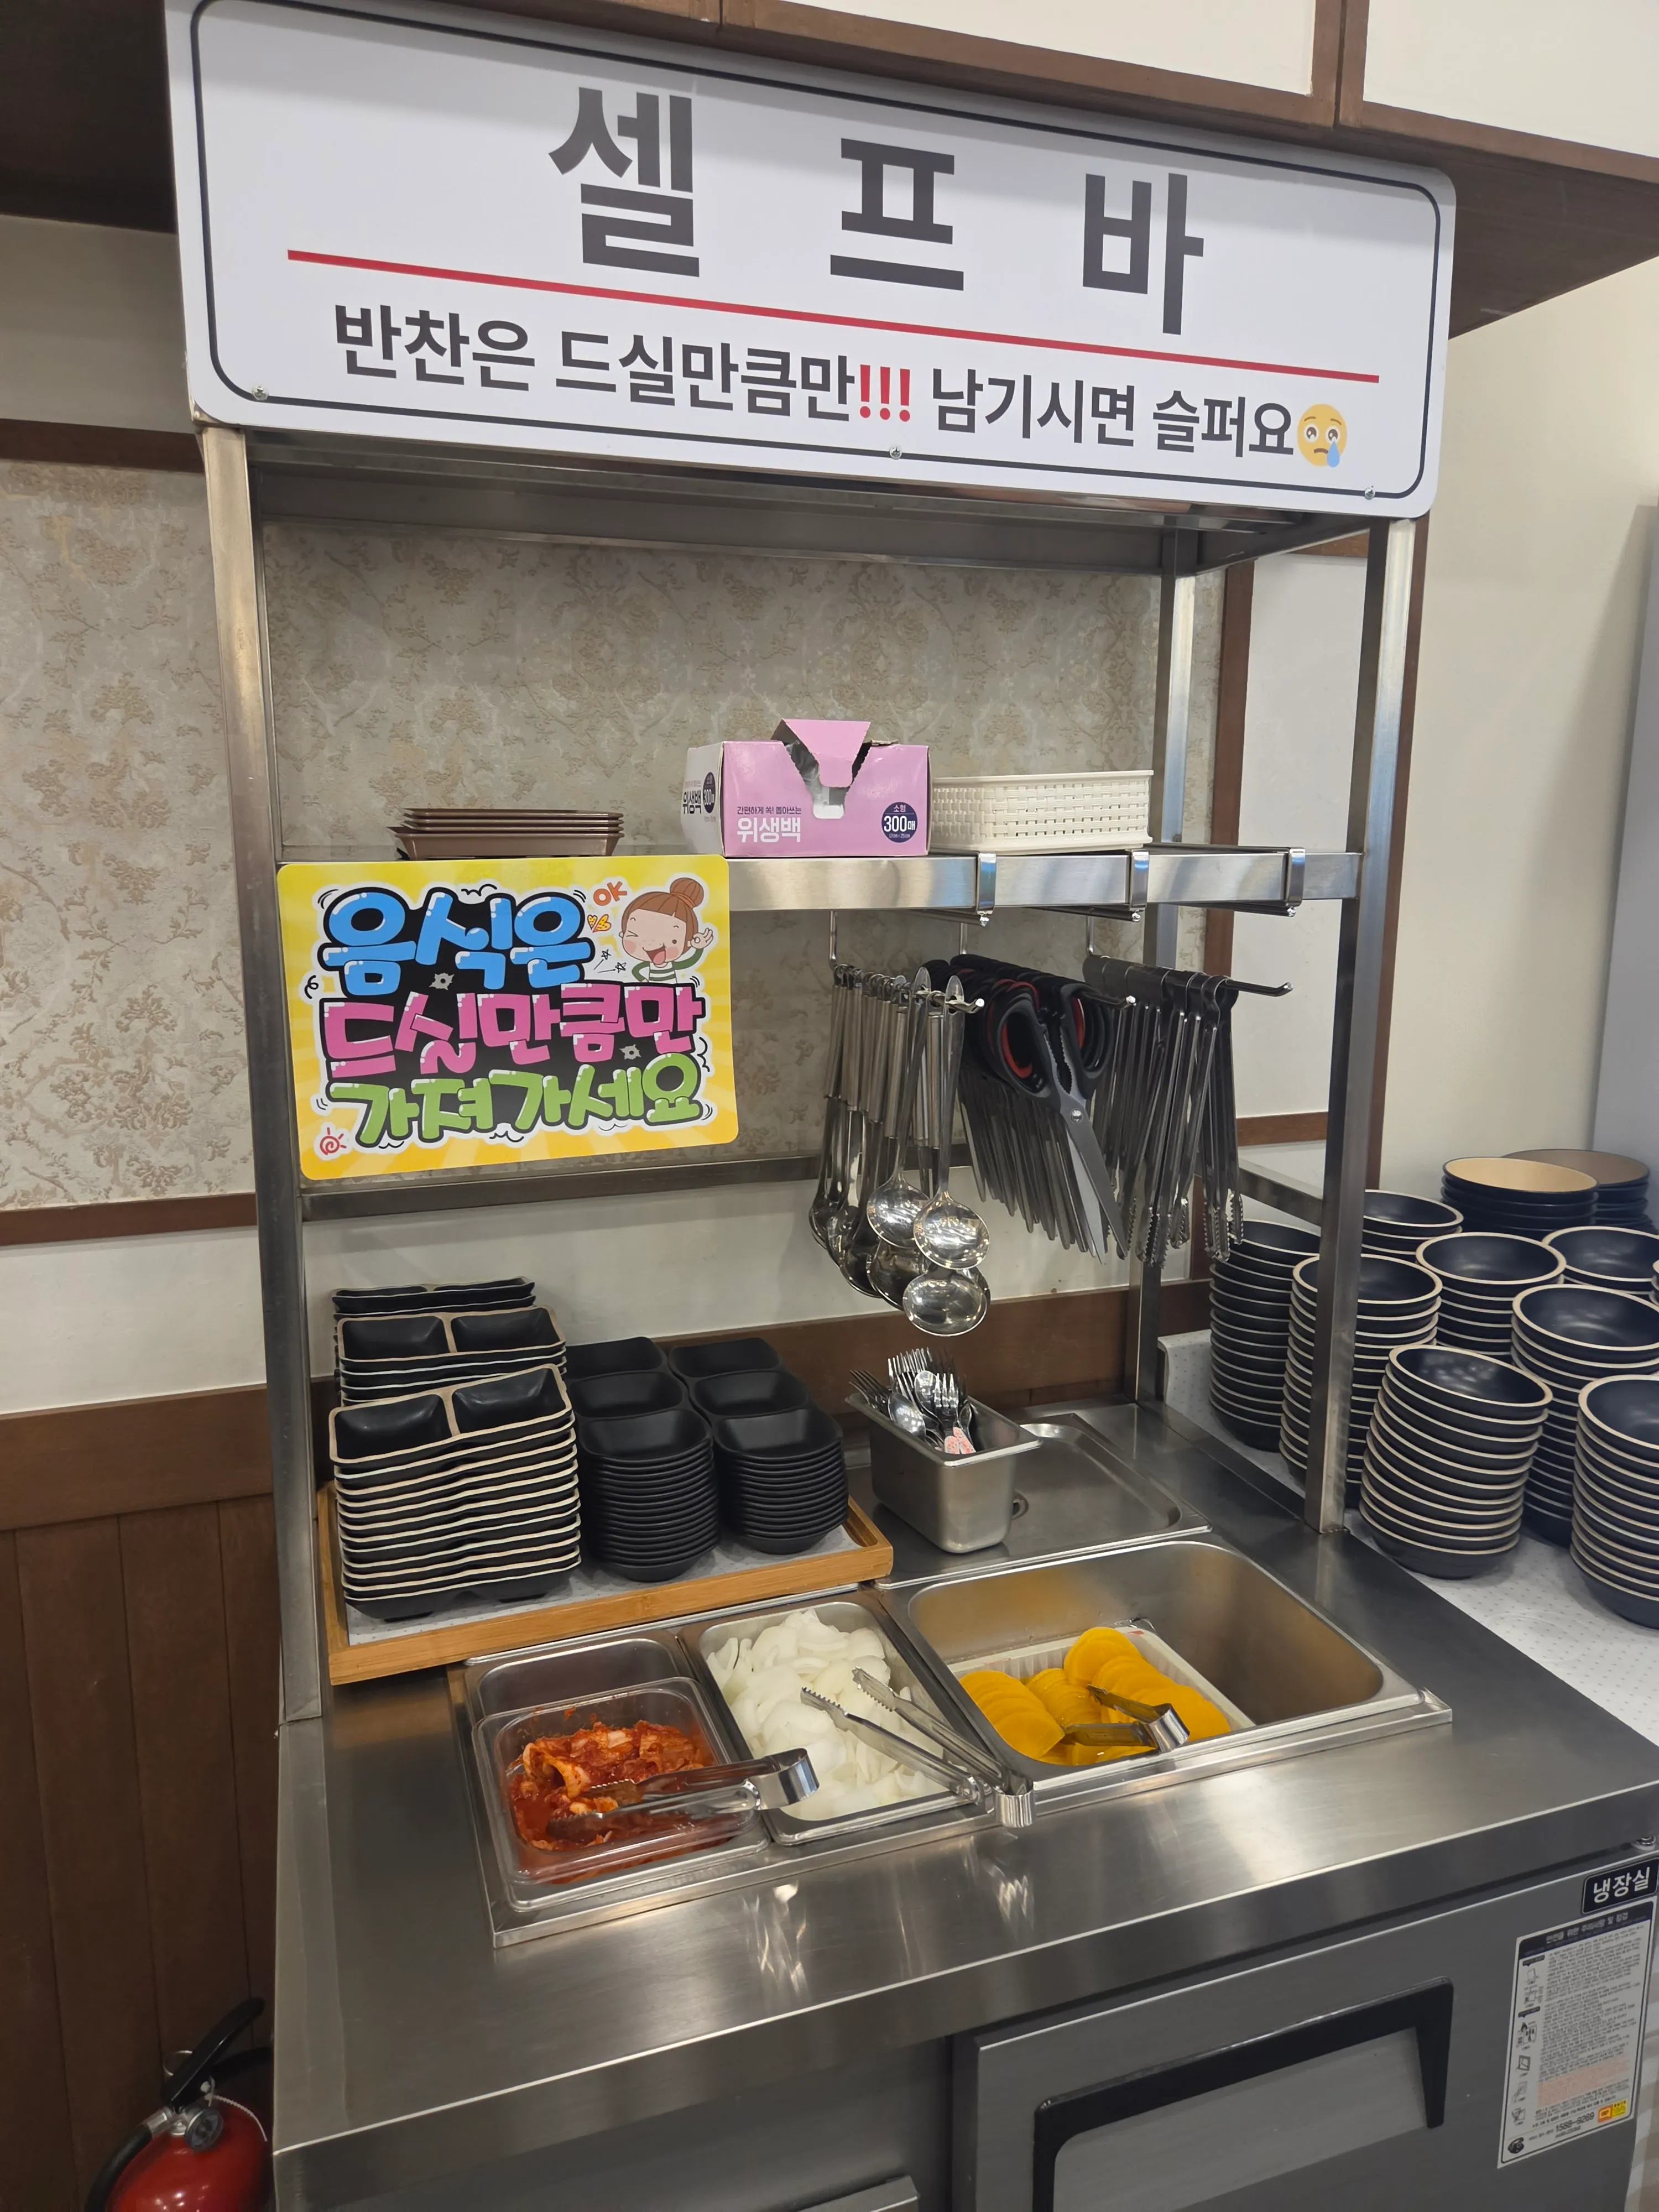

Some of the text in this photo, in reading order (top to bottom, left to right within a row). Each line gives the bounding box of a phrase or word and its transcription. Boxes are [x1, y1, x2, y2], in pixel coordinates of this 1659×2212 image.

[549, 87, 1204, 335] 셀 프 바
[335, 305, 1294, 457] 반찬은 드실만큼만!!! 남기시면 슬퍼요
[682, 790, 701, 815] 위생백
[737, 806, 764, 815] 간편하게
[737, 817, 801, 843] 위생백
[884, 815, 916, 832] 300매
[593, 881, 628, 906] OK
[321, 888, 593, 995] 음식은
[324, 982, 703, 1078] 드실만큼만
[328, 1052, 700, 1145] 가져가세요
[1593, 1866, 1650, 1903] 냉장실
